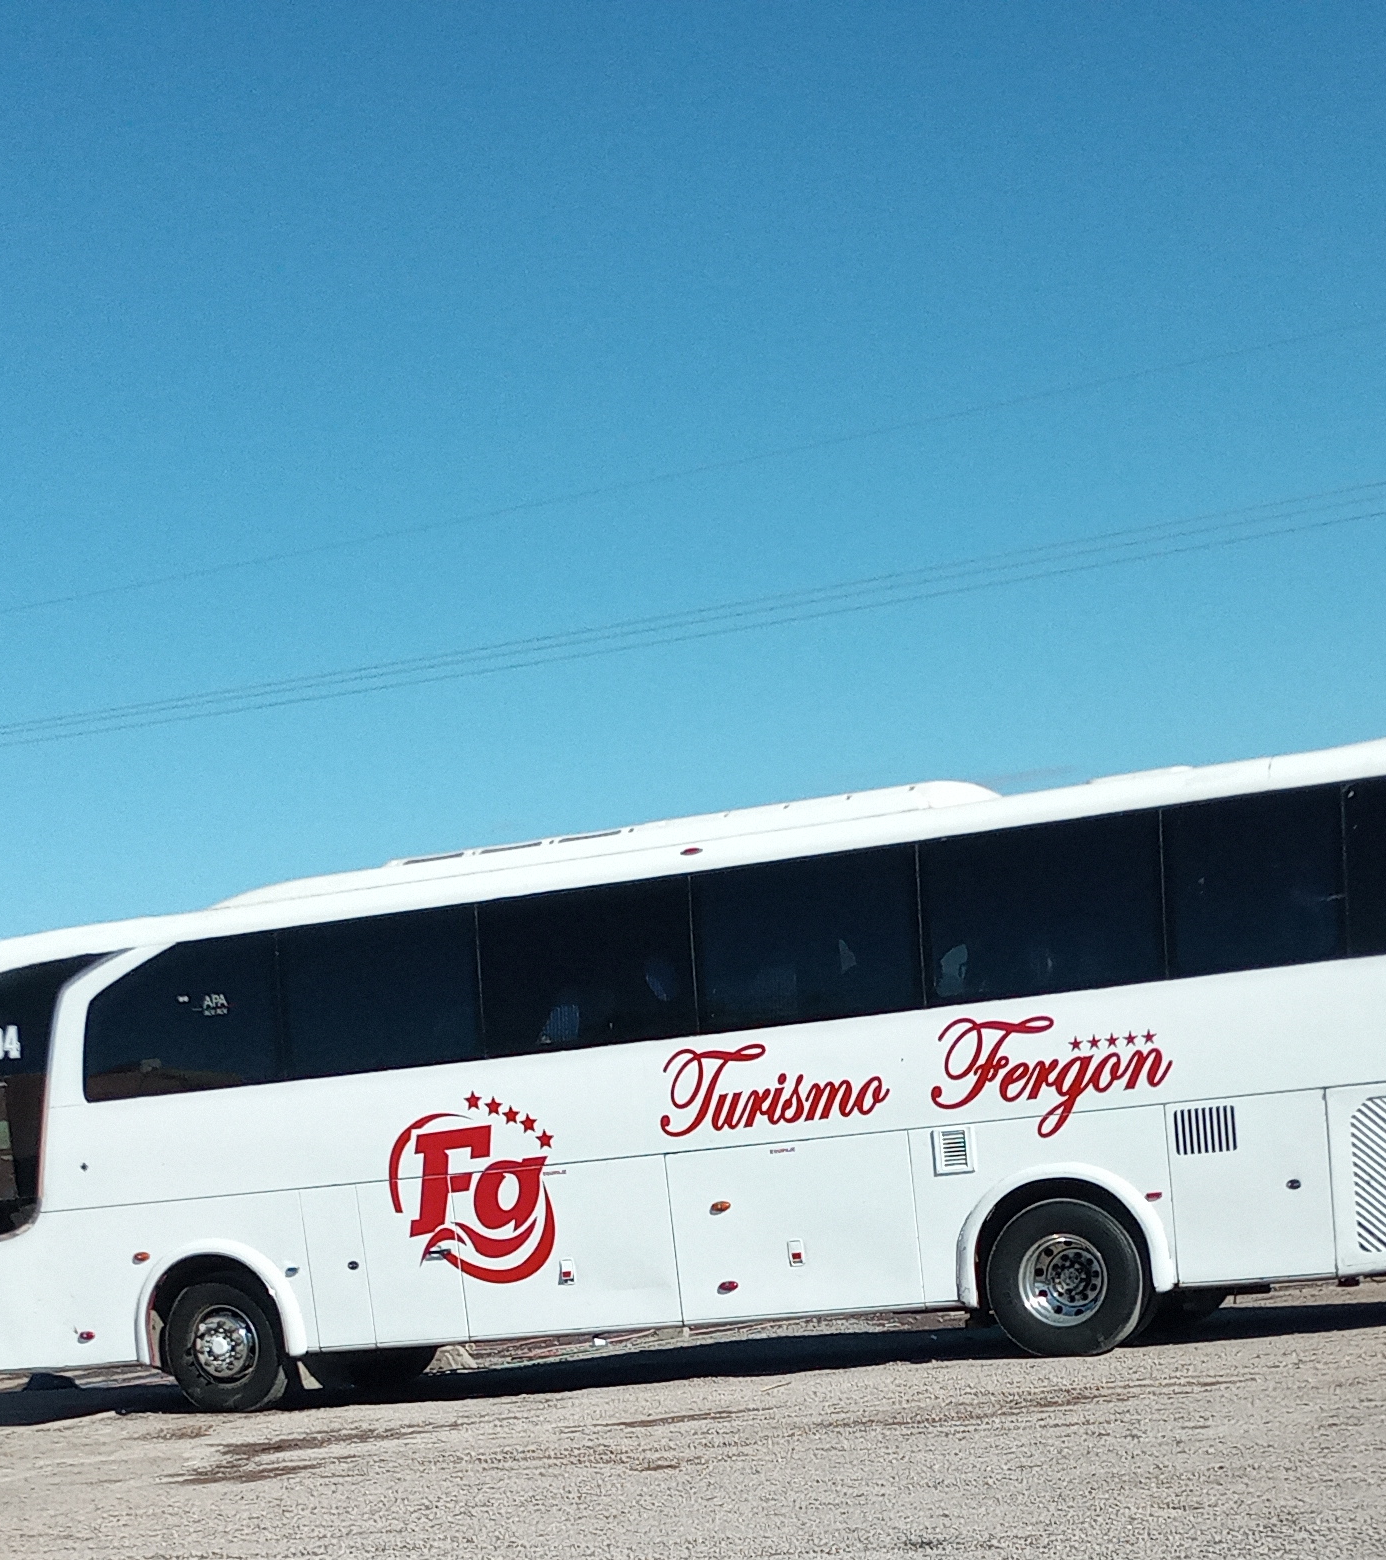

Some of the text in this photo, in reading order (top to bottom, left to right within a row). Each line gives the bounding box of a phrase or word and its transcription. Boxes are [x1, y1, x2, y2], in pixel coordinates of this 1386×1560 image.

[660, 1015, 1173, 1138] Turismo Fergon
[409, 1124, 548, 1258] Fg
